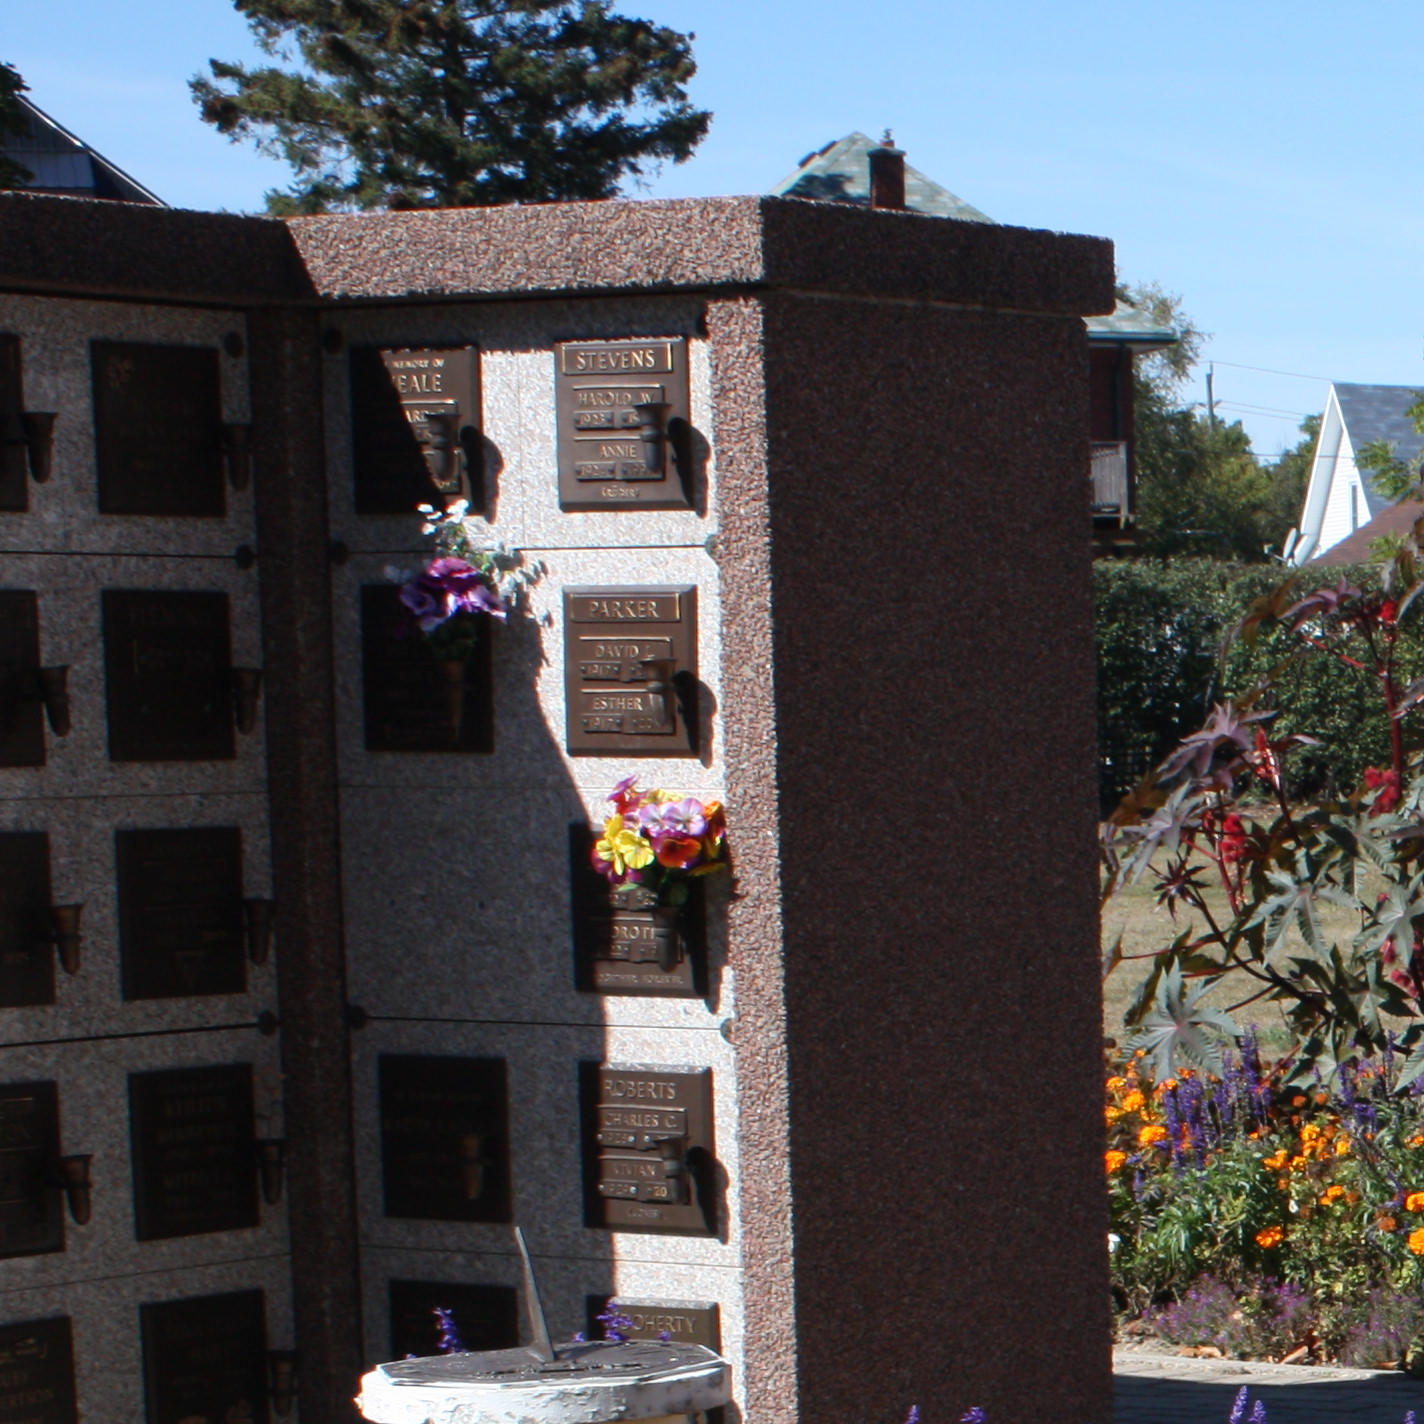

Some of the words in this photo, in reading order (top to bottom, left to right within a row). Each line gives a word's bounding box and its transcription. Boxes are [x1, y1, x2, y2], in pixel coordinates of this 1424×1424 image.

[576, 350, 655, 370] STEVENS
[392, 374, 442, 394] EALE
[578, 391, 632, 406] HAROLD
[600, 445, 637, 458] ANNIE
[590, 601, 659, 619] PARKER
[596, 645, 639, 658] DAVID
[593, 697, 643, 711] ESTHER
[605, 1079, 676, 1100] ROBERTS
[605, 1113, 659, 1128] CHARLES
[613, 1163, 657, 1176] VIVIAN
